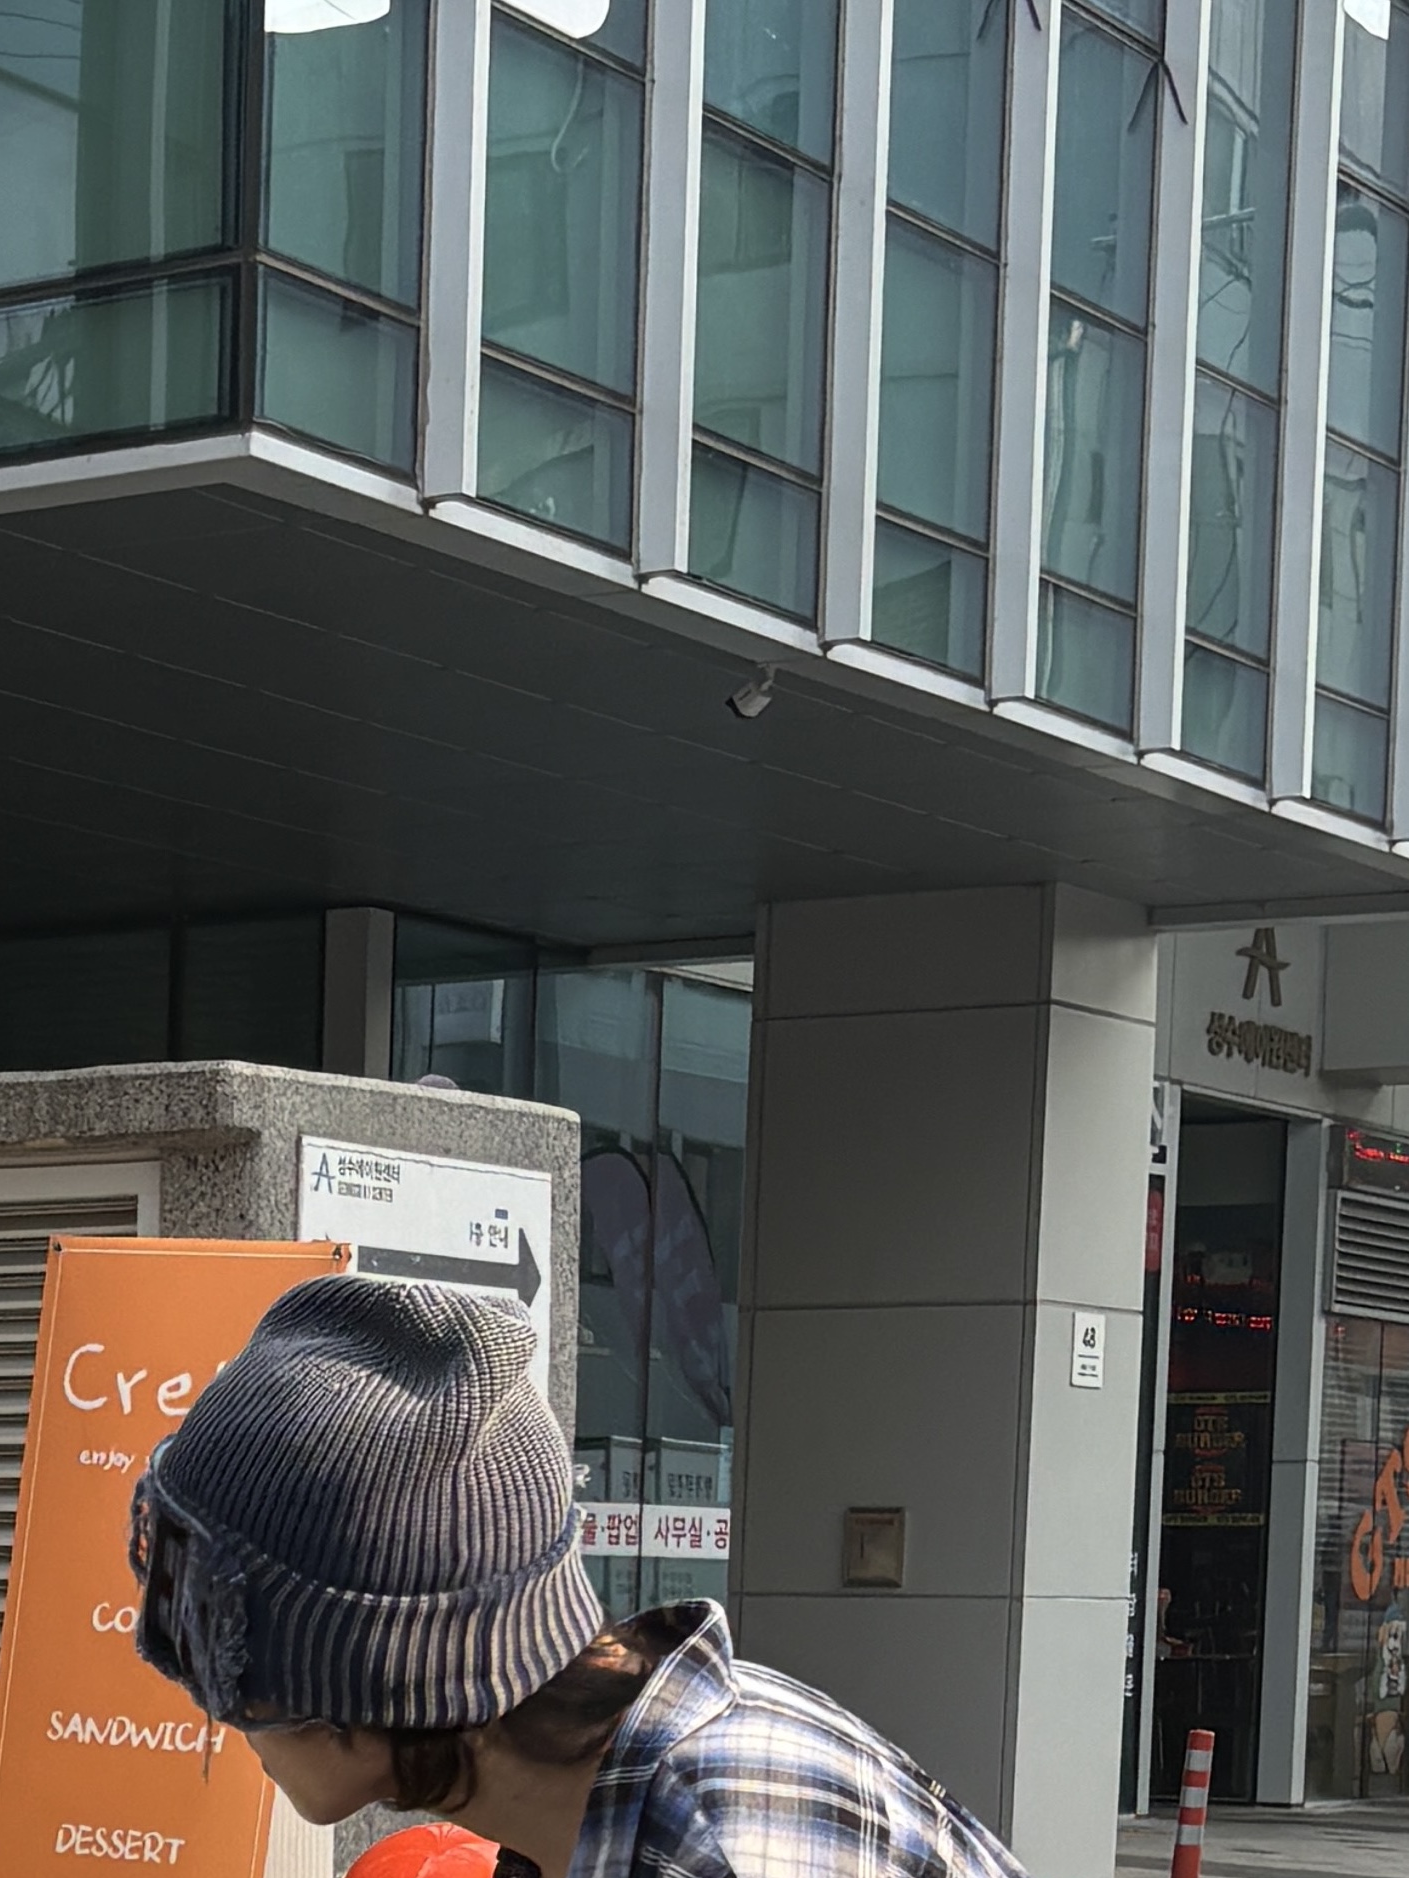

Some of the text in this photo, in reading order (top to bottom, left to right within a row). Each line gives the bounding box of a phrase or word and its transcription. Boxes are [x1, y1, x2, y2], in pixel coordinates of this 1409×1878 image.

[488, 1224, 508, 1249] 안내
[63, 1343, 227, 1416] Cre
[79, 1448, 135, 1474] enjoy
[46, 1710, 226, 1754] SANDWICH
[56, 1824, 185, 1864] DESSERT
